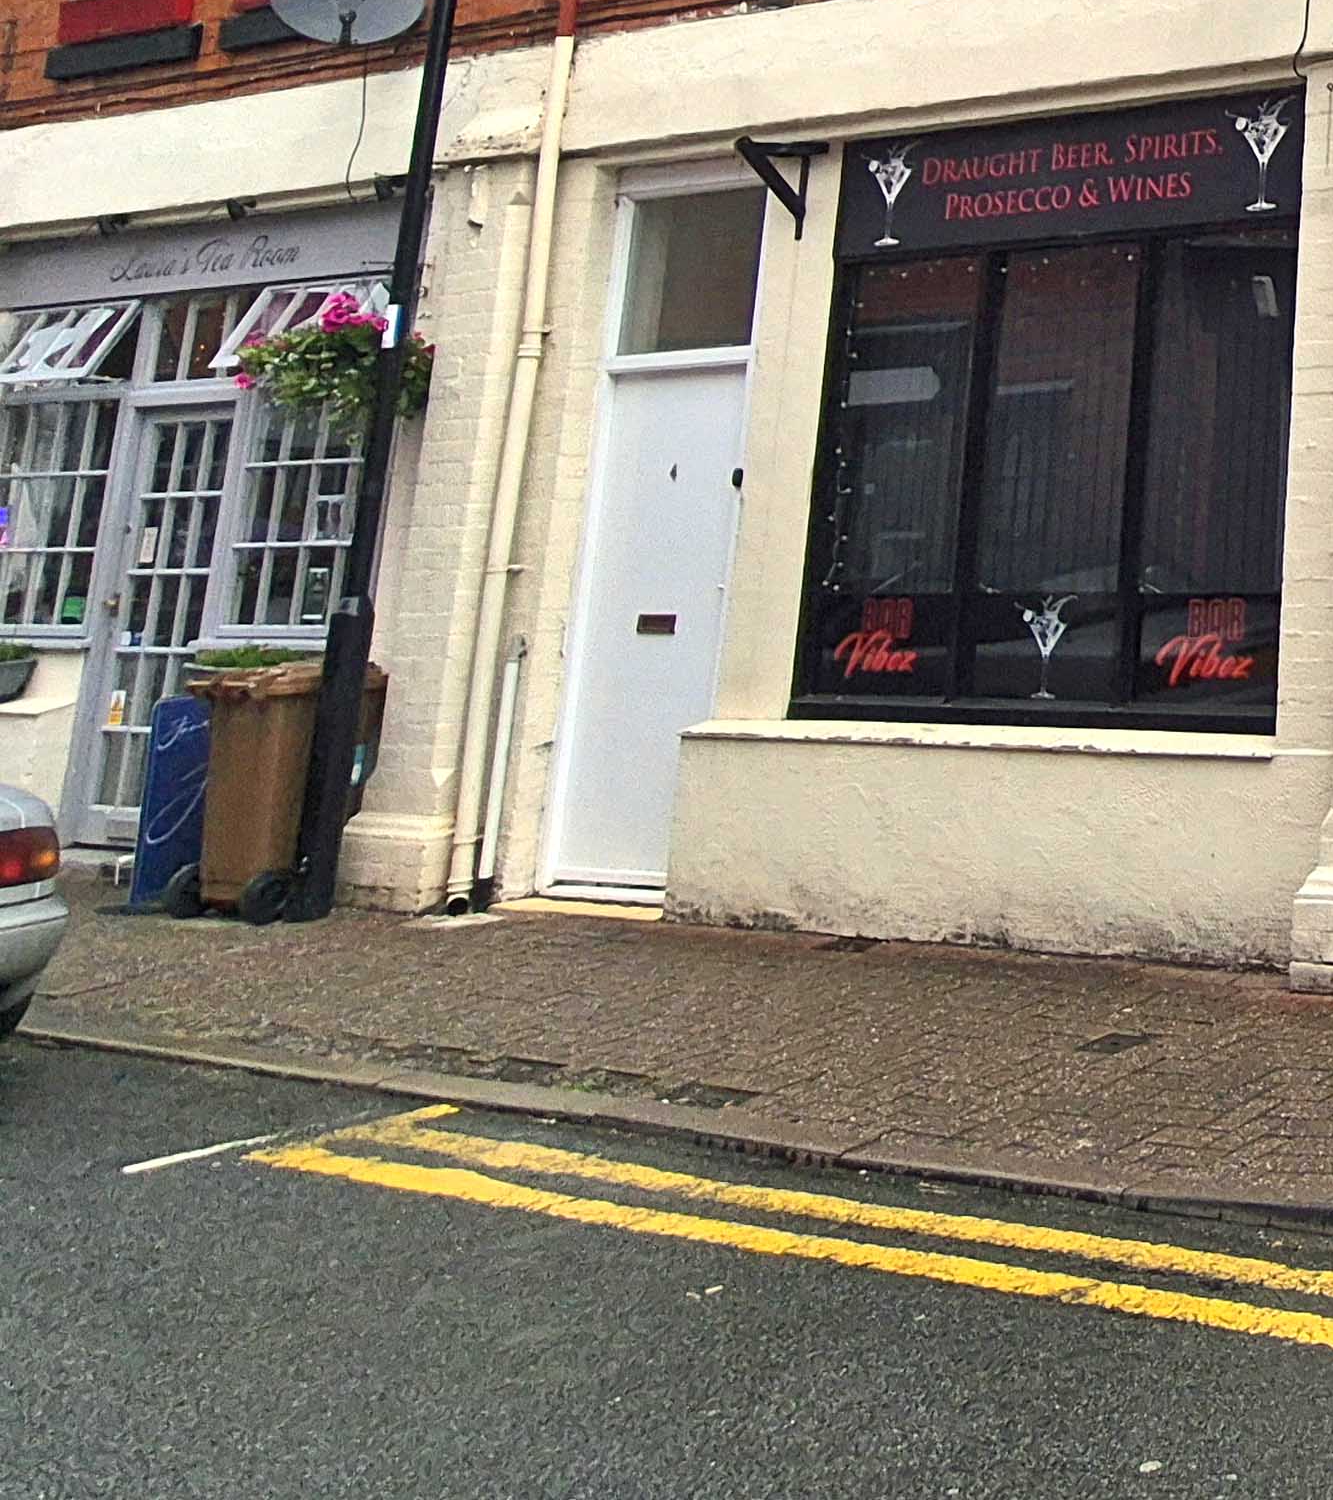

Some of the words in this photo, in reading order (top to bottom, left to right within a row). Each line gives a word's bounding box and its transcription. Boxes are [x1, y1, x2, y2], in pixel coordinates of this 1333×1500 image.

[921, 149, 1042, 186] DRAUGHT
[944, 185, 1071, 220] PROSECCO
[1078, 178, 1100, 207] &
[1107, 172, 1193, 203] WINES
[198, 239, 232, 274] Tea
[240, 235, 299, 269] Room
[833, 628, 918, 678] Vibez
[1155, 632, 1256, 687] Vibez
